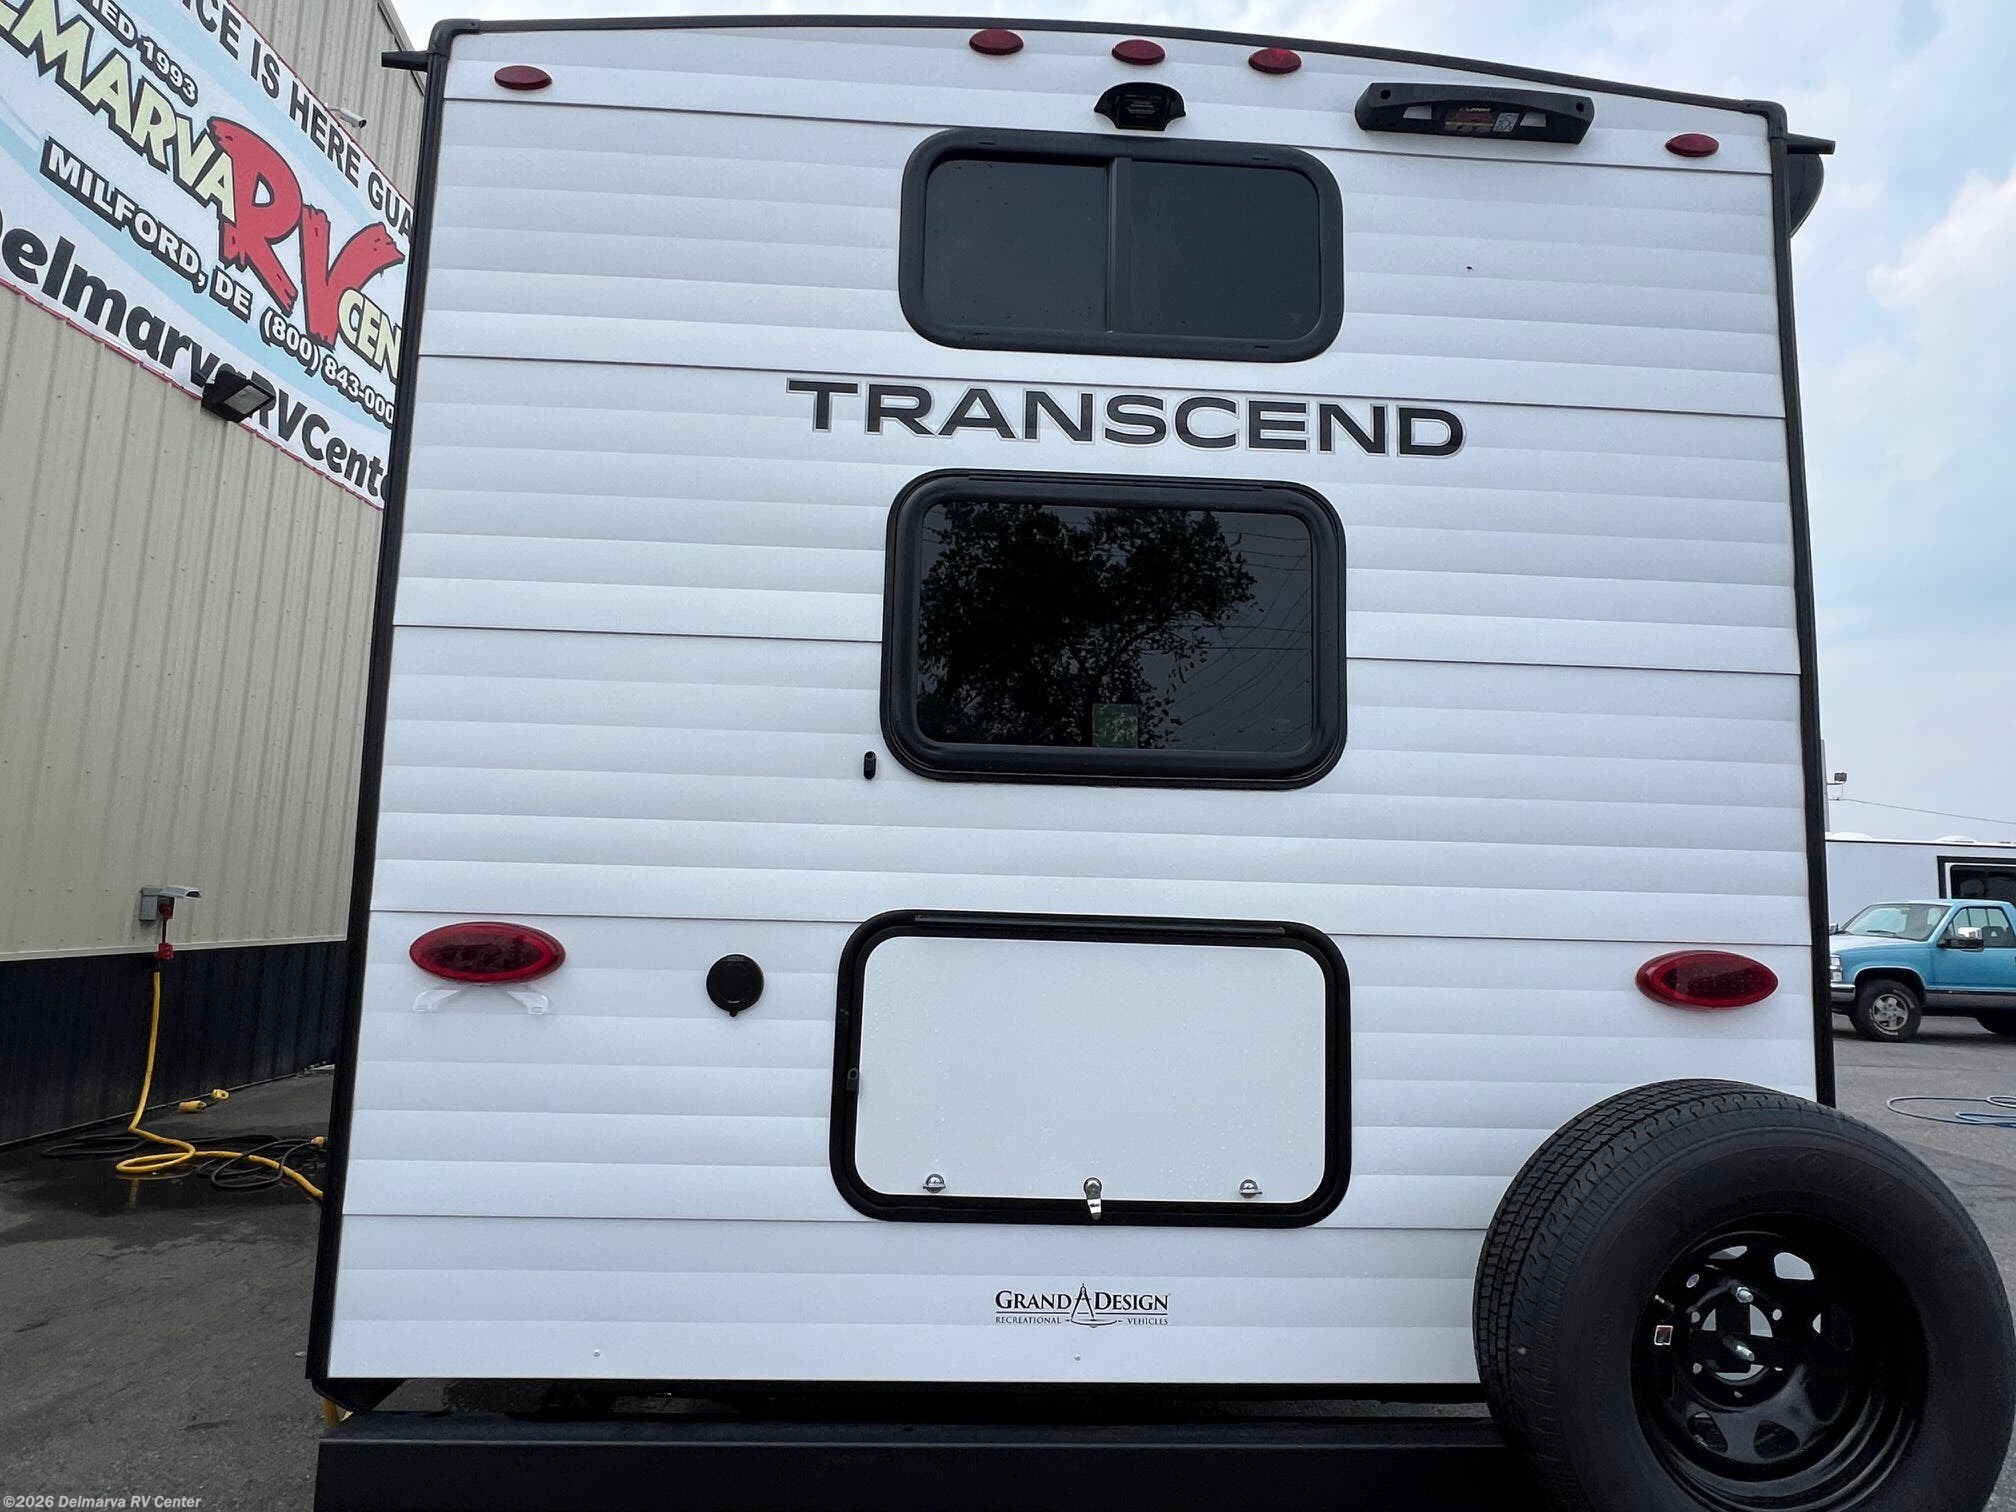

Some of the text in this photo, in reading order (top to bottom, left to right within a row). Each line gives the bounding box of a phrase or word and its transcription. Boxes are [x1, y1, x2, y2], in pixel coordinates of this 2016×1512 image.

[88, 0, 198, 104] ED 1993
[183, 0, 242, 61] CE
[251, 38, 281, 99] IS
[289, 80, 361, 189] HERE
[42, 140, 209, 289] MILFORD,
[211, 268, 253, 318] DE
[262, 307, 320, 375] (800)
[208, 117, 405, 350] RV
[337, 286, 401, 385] CEN
[786, 377, 1465, 457] TRANSCEND
[995, 1290, 1168, 1311] GRAND DESIGN
[995, 1316, 1168, 1326] RECREATIONAL VEHICLES
